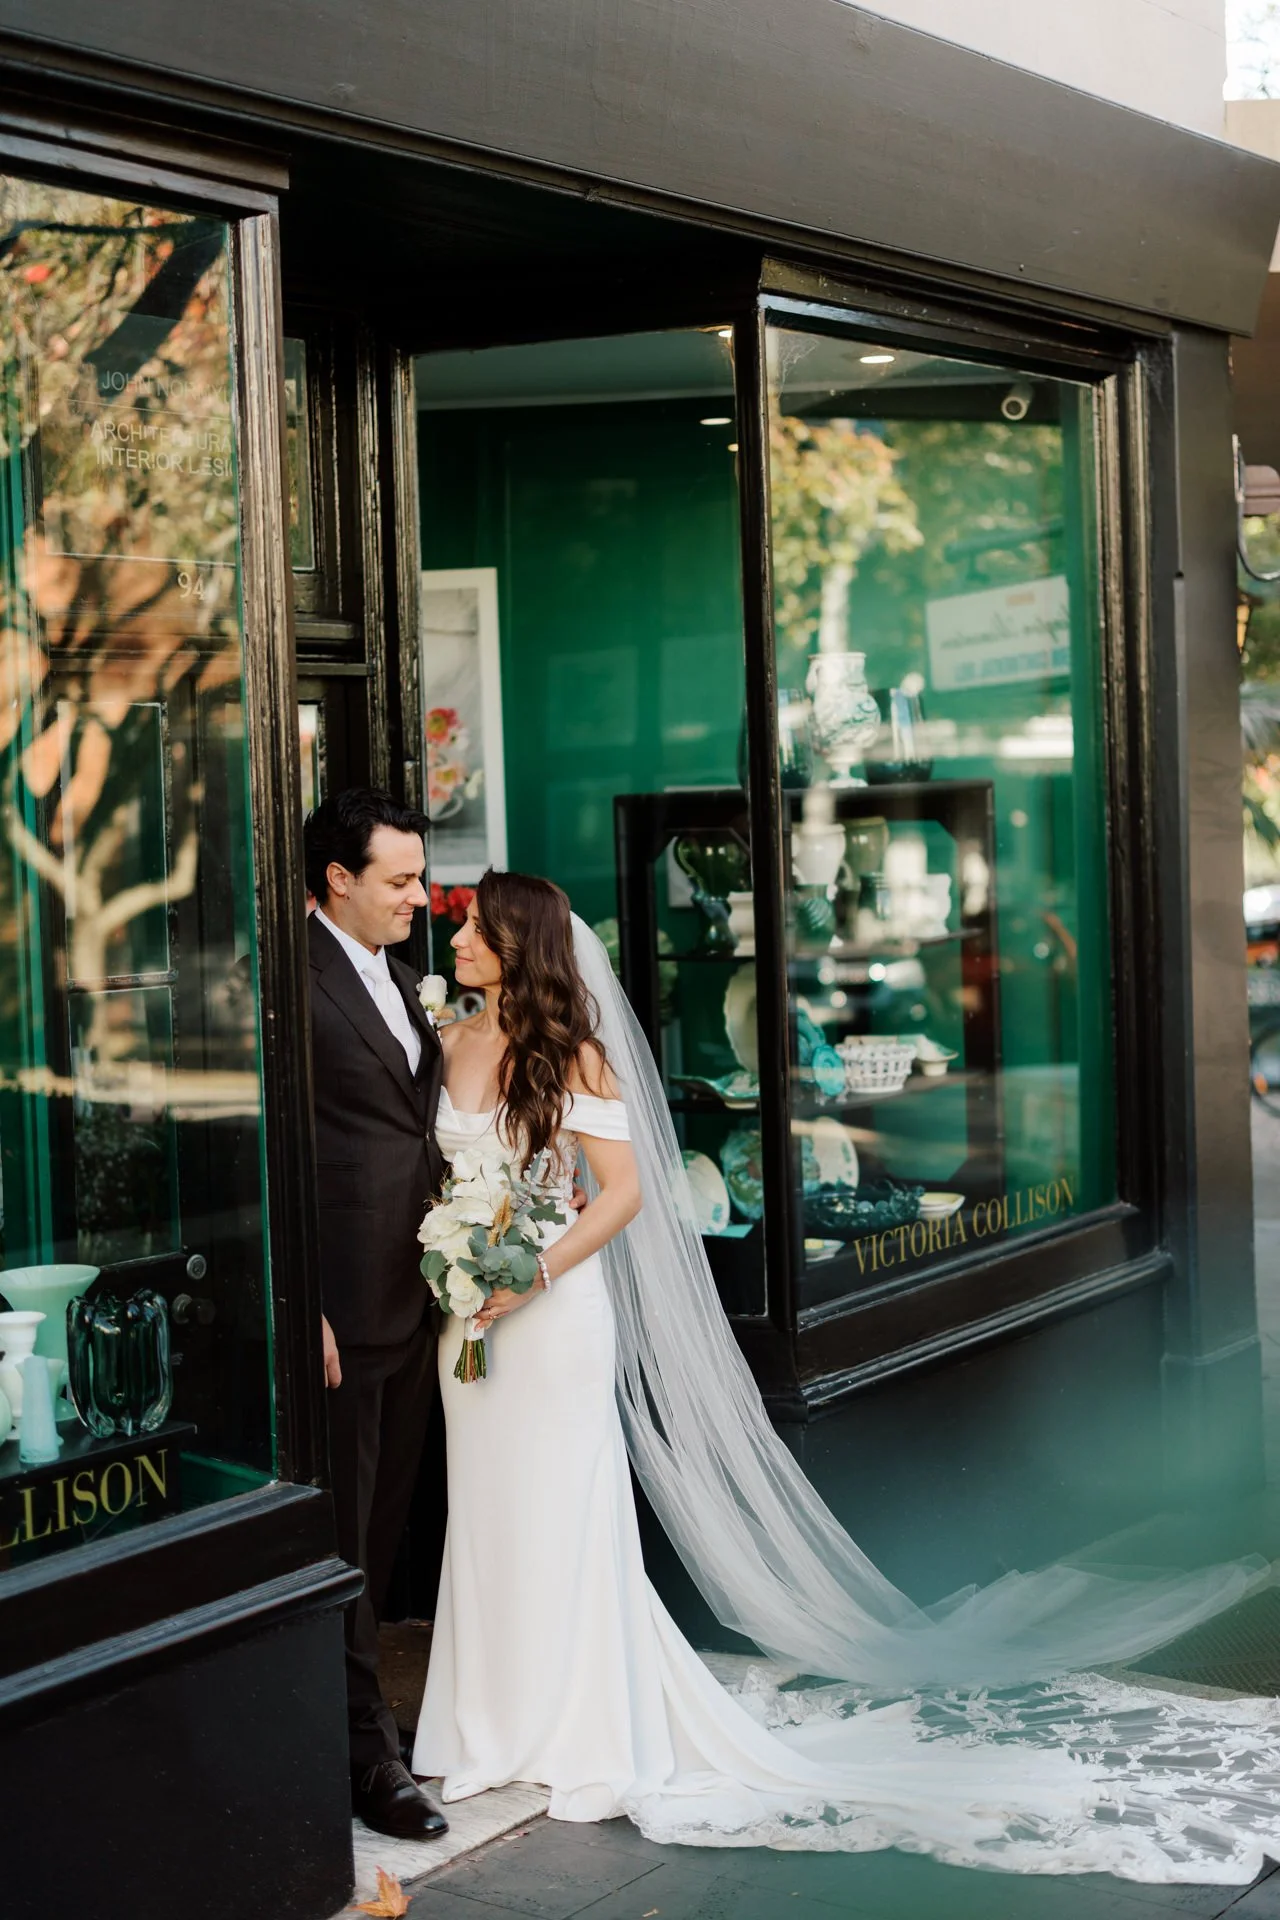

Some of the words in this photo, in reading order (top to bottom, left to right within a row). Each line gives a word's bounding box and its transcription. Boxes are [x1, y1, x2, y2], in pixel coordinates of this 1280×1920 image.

[101, 370, 151, 396] JOHN
[96, 446, 184, 473] INTERIOR
[177, 571, 205, 601] 94
[853, 1212, 967, 1275] VICTORIA
[972, 1175, 1075, 1238] COLLISON
